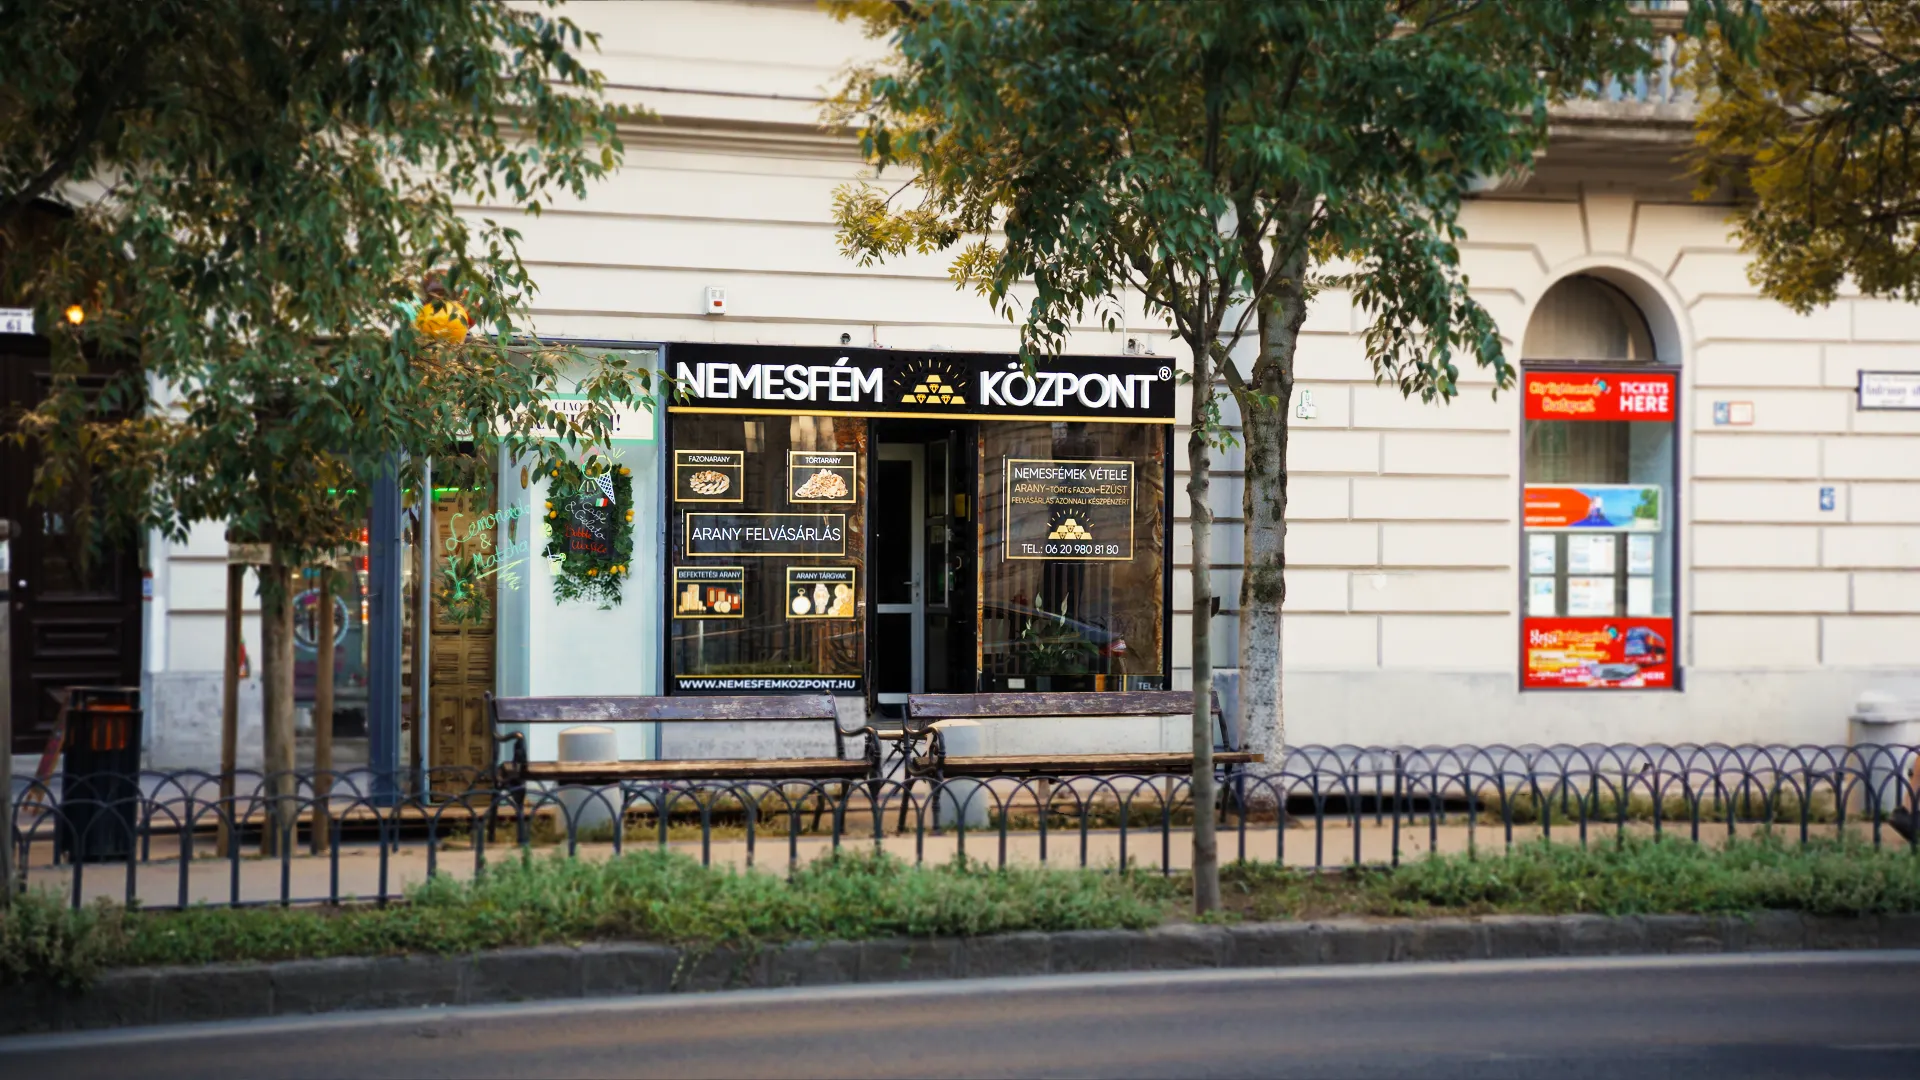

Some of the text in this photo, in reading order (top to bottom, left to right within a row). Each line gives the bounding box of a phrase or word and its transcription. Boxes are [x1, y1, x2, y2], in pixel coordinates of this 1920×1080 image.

[676, 356, 884, 403] NEMESFÉM
[1619, 382, 1669, 394] TICKETS
[1619, 395, 1669, 412] HERE
[688, 455, 731, 463] FAZONARANY
[1014, 466, 1128, 481] NEMESFÉMEK VÉTELE
[575, 509, 606, 540] Gelato
[691, 524, 841, 541] ARANY FELVÁSÁRLÁS
[1021, 544, 1119, 555] TEL.: 06 20 980 81 80
[472, 538, 529, 576] Matcha
[678, 570, 742, 579] BEFEKTETÉSI ARANY
[796, 571, 847, 580] ARANY TÁRGYAK
[679, 679, 856, 690] WWW.NEMESFEMKOZPONT.HU
